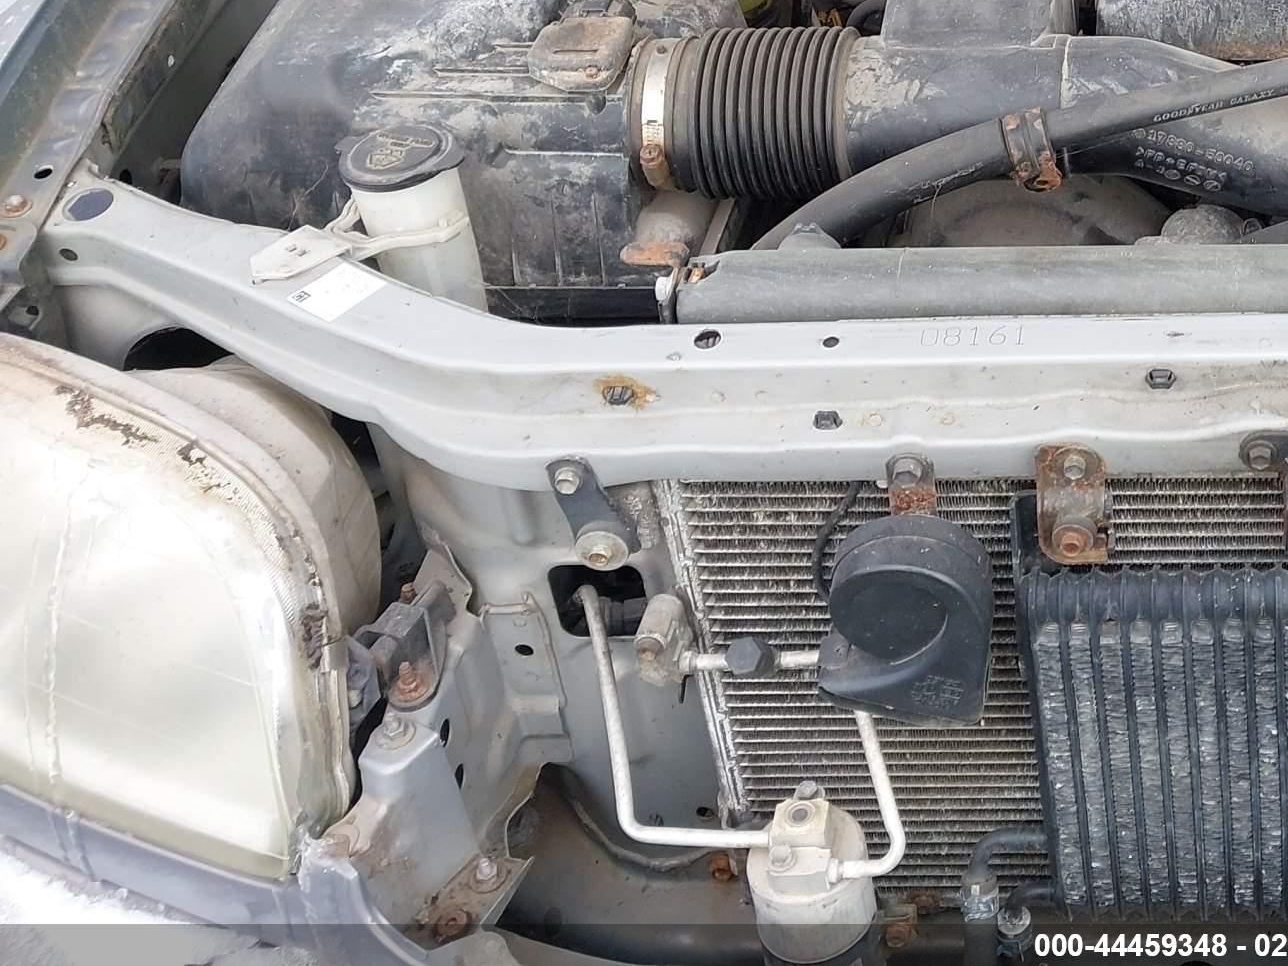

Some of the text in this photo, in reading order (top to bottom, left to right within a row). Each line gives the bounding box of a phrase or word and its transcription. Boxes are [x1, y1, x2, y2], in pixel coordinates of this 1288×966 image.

[1153, 89, 1276, 124] GOODYEAR GALAXY
[920, 324, 1025, 347] 08161
